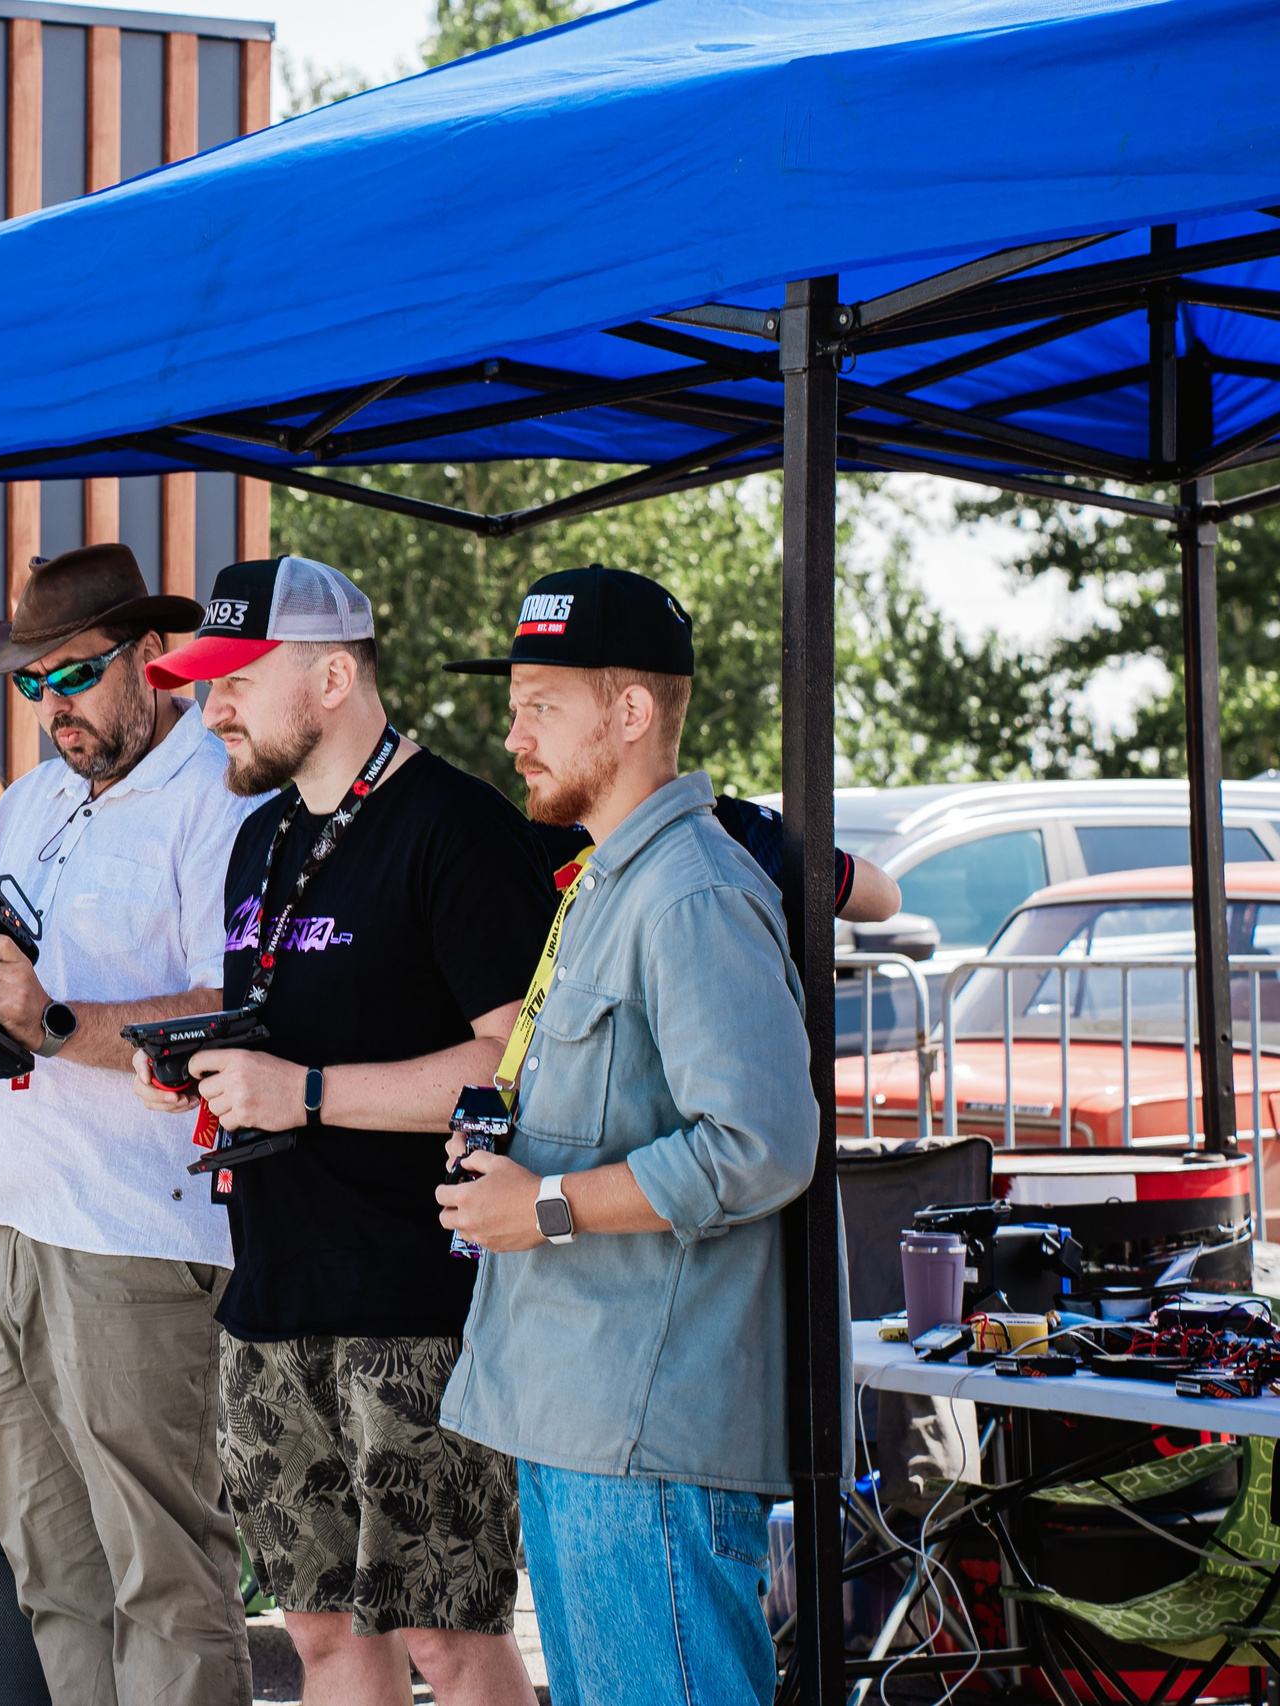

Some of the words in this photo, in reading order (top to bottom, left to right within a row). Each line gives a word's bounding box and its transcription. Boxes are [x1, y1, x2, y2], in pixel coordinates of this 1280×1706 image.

[364, 741, 394, 782] TAKAYAMA
[267, 903, 293, 953] TAKAYAMA
[169, 1029, 206, 1042] SANWA
